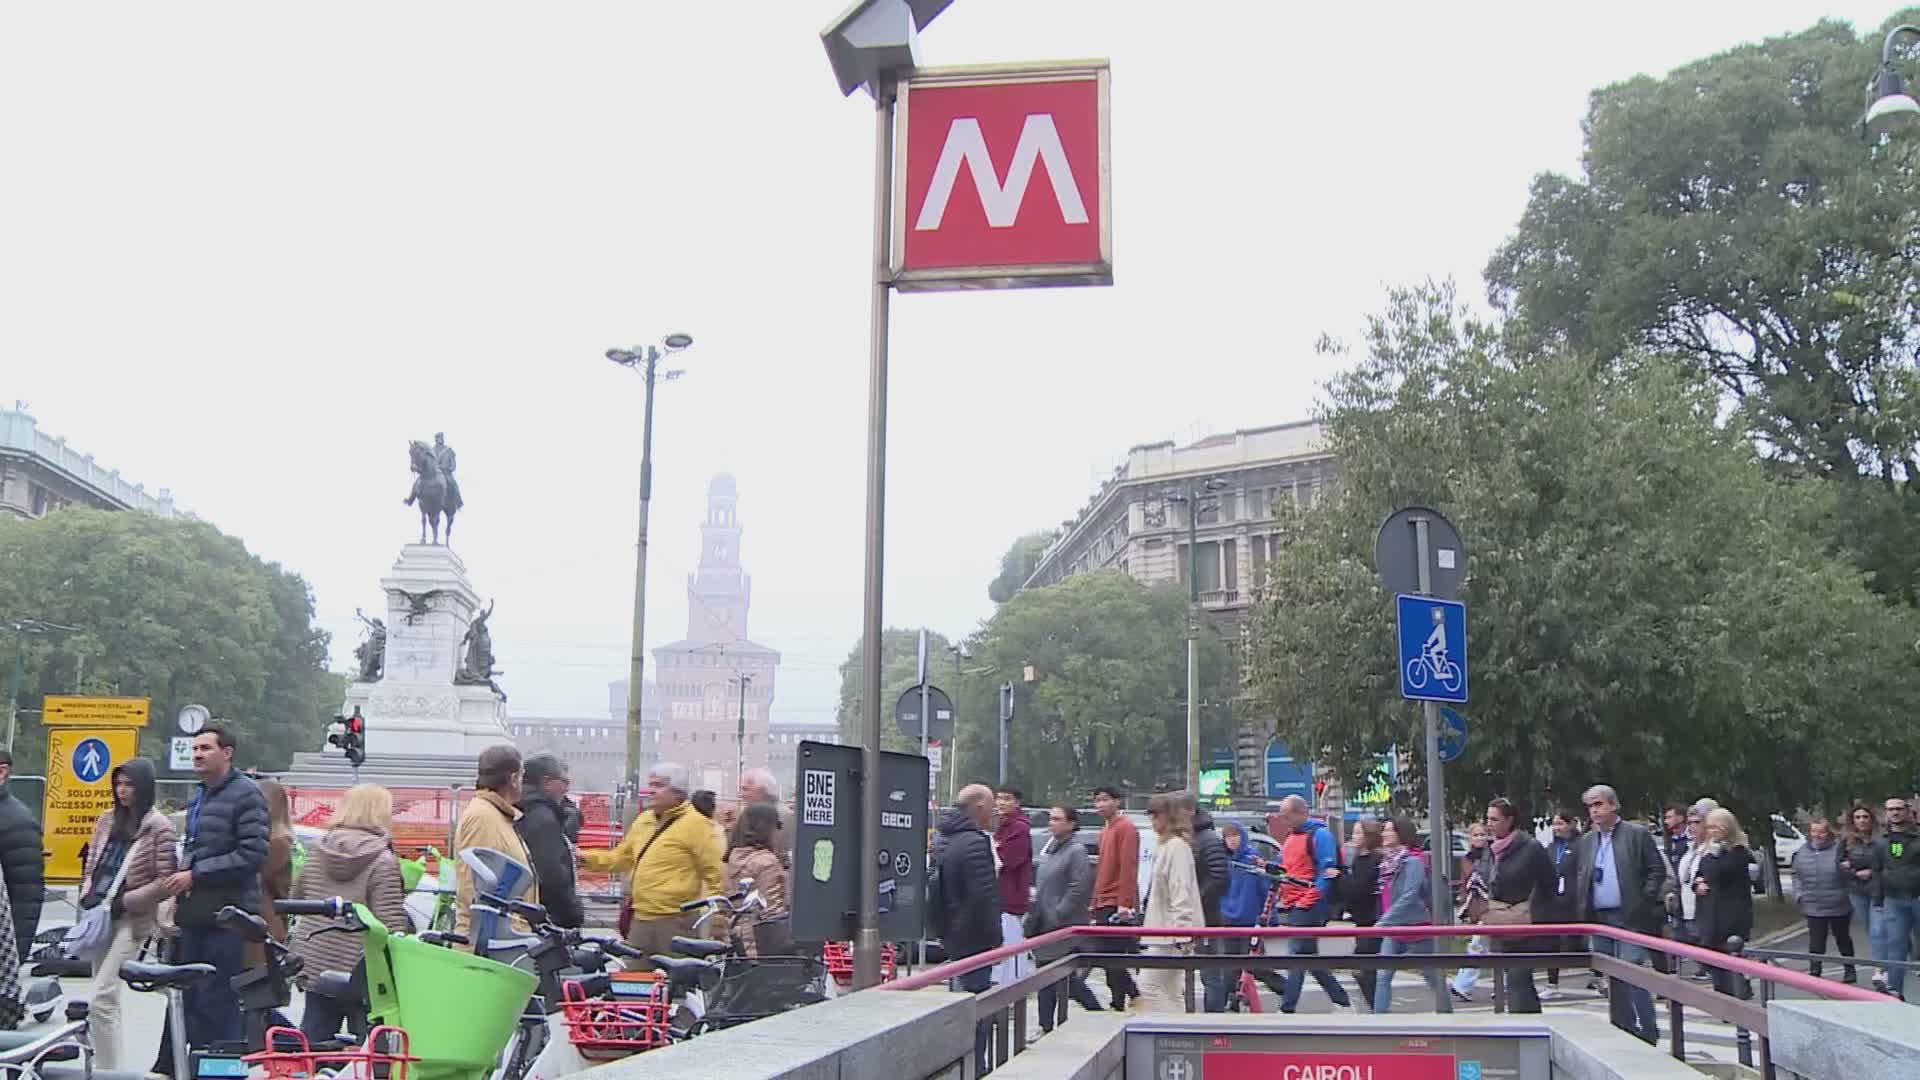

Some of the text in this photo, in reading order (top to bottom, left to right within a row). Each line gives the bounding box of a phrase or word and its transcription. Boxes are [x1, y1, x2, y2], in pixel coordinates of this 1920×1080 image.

[915, 113, 1090, 231] M
[806, 773, 833, 796] BNE
[67, 789, 93, 798] SOLO
[49, 801, 93, 809] ACCESSO
[806, 797, 832, 809] WAS
[805, 810, 832, 822] HERE
[55, 826, 93, 835] ACCESS
[1283, 1064, 1373, 1080] CAIROLI
